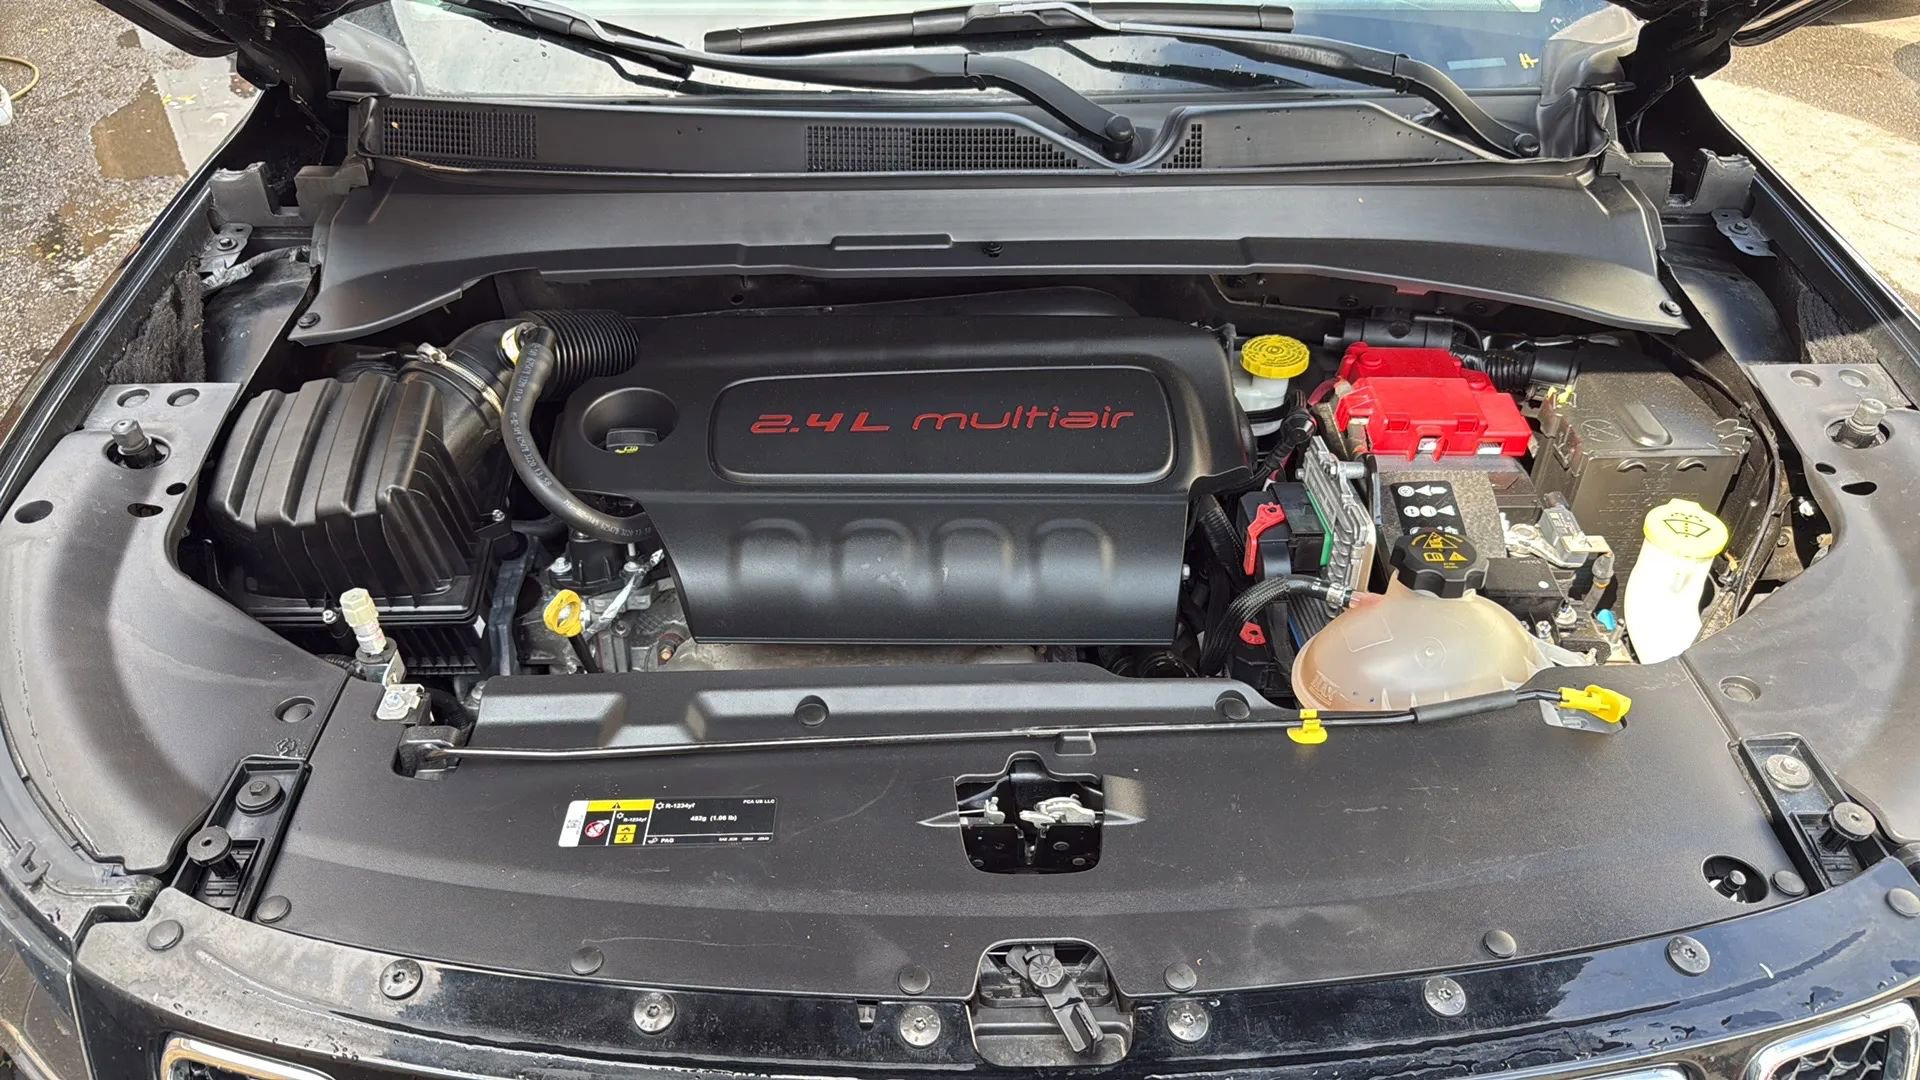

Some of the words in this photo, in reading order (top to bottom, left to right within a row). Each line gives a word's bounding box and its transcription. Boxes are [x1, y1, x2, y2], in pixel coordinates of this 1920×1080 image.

[750, 412, 891, 433] 2.4L
[911, 405, 1134, 431] multiair
[665, 802, 696, 810] R-1234yf
